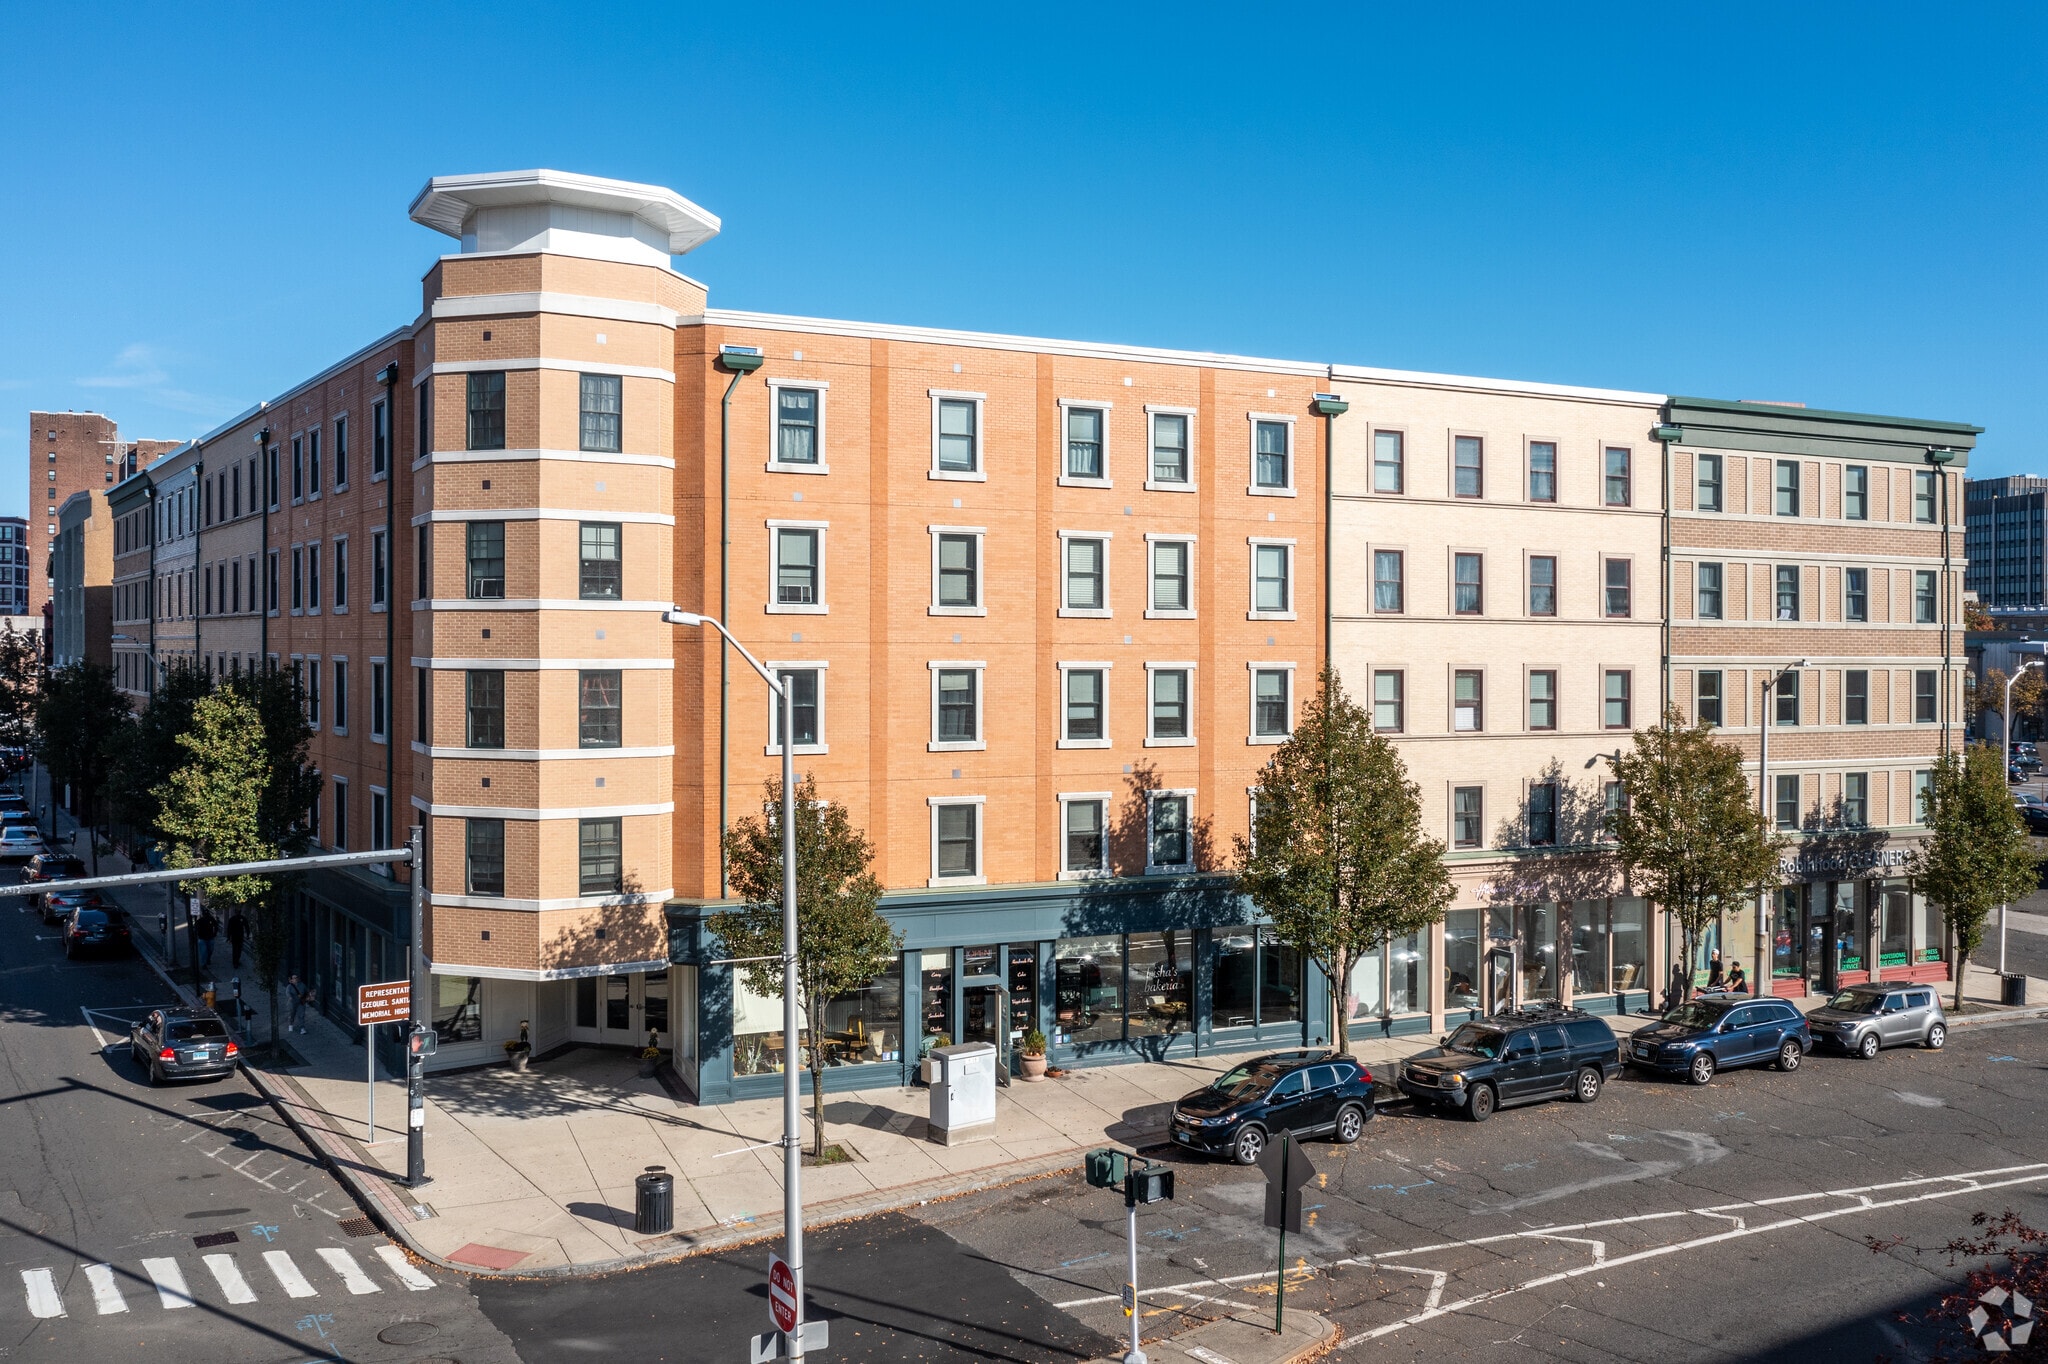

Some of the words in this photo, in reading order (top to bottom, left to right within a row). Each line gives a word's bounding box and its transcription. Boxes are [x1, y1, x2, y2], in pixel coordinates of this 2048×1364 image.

[1780, 854, 1847, 873] Robinhood
[366, 987, 410, 998] REPRESENTATI
[362, 1000, 388, 1008] EZEQUIEL
[392, 997, 410, 1006] SANTI
[362, 1010, 392, 1019] MEMORIAL
[772, 1270, 780, 1282] DO
[783, 1278, 794, 1292] NOT
[776, 1302, 792, 1322] ENTER
